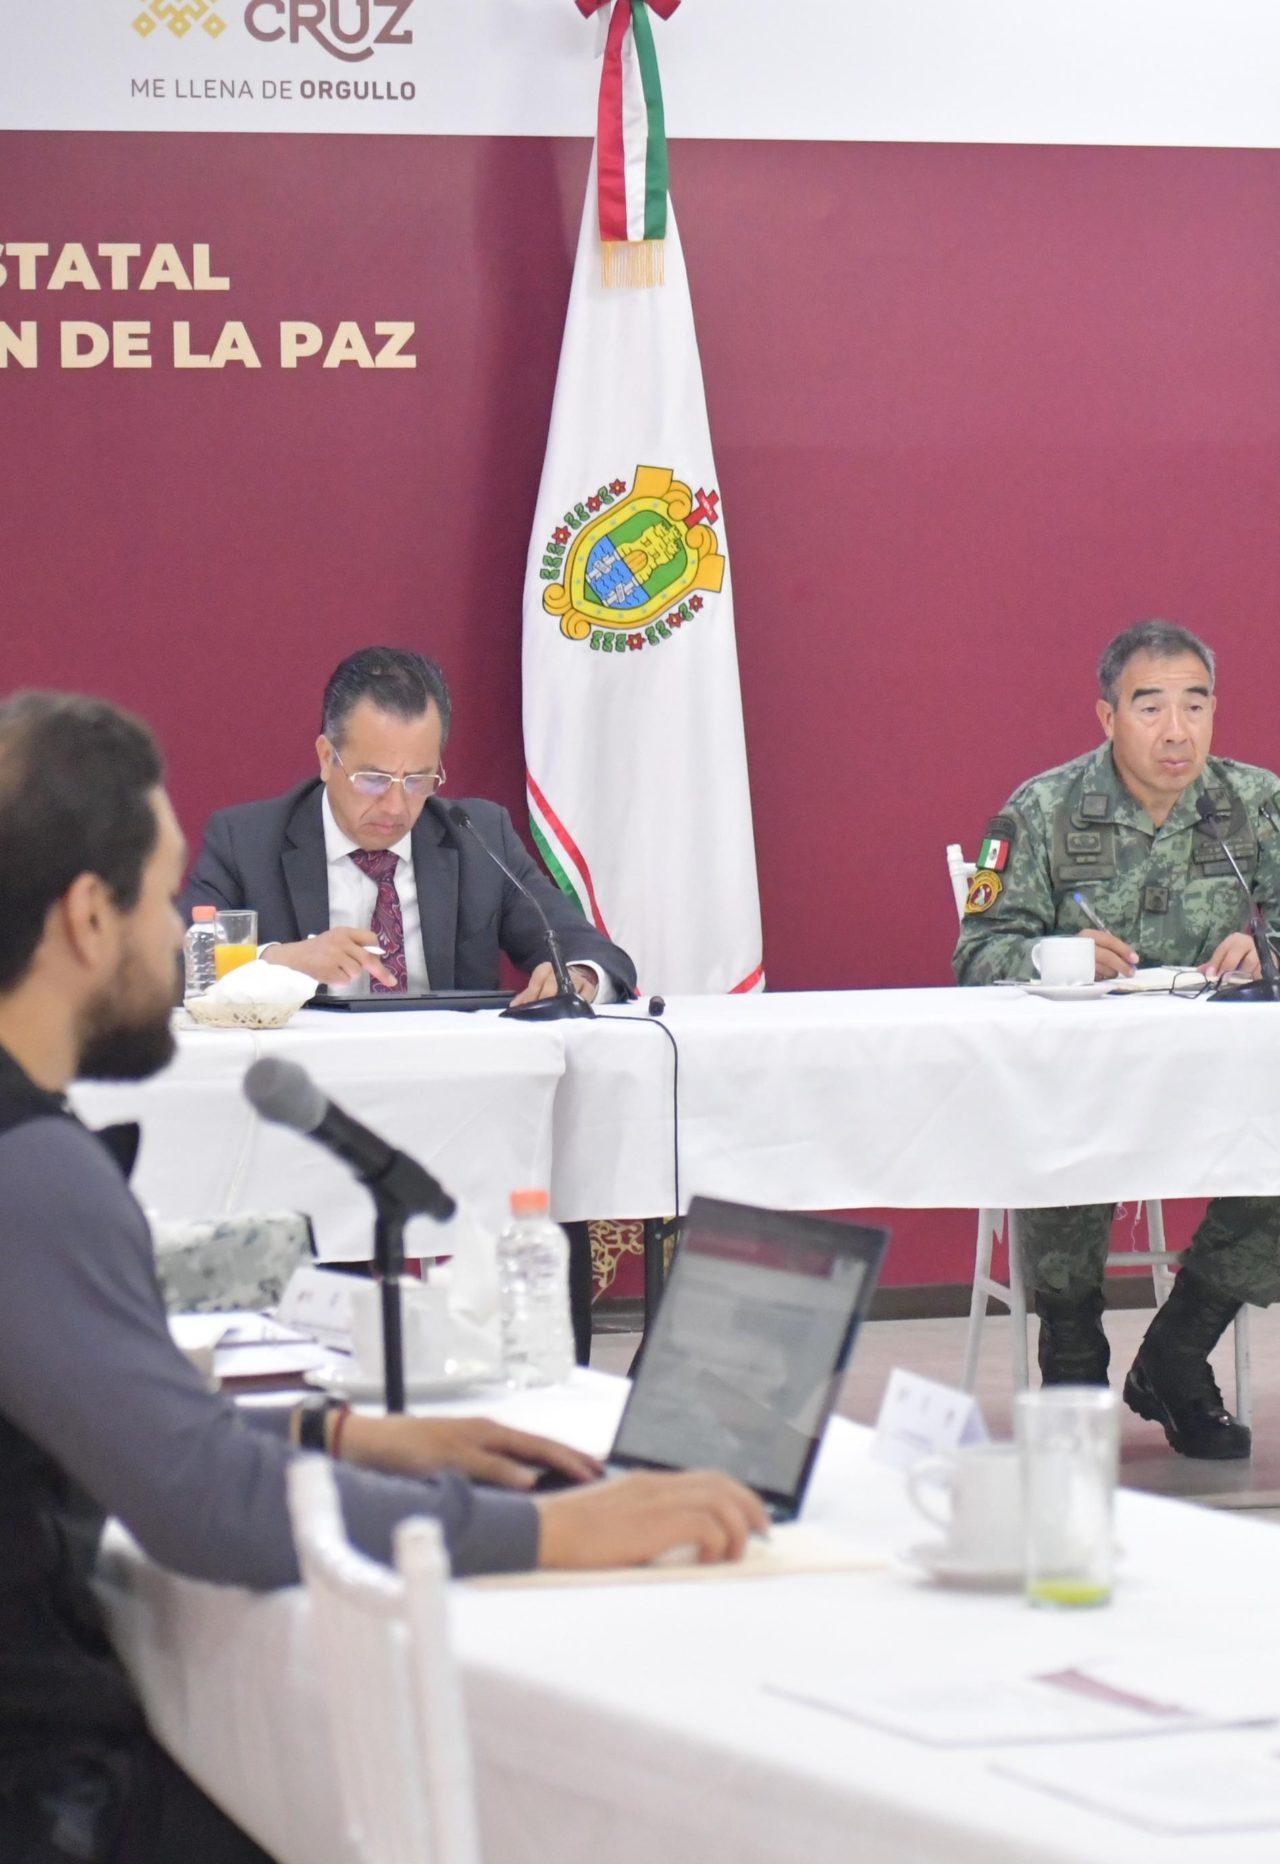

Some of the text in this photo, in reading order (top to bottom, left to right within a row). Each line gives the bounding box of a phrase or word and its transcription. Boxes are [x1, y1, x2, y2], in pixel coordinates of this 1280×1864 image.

[244, 0, 413, 62] CRUZ
[131, 79, 416, 101] ME LLENA DE ORGULLO
[0, 243, 231, 290] TATAL
[60, 320, 152, 369] DE
[173, 320, 262, 369] LA
[280, 321, 417, 369] PAZ
